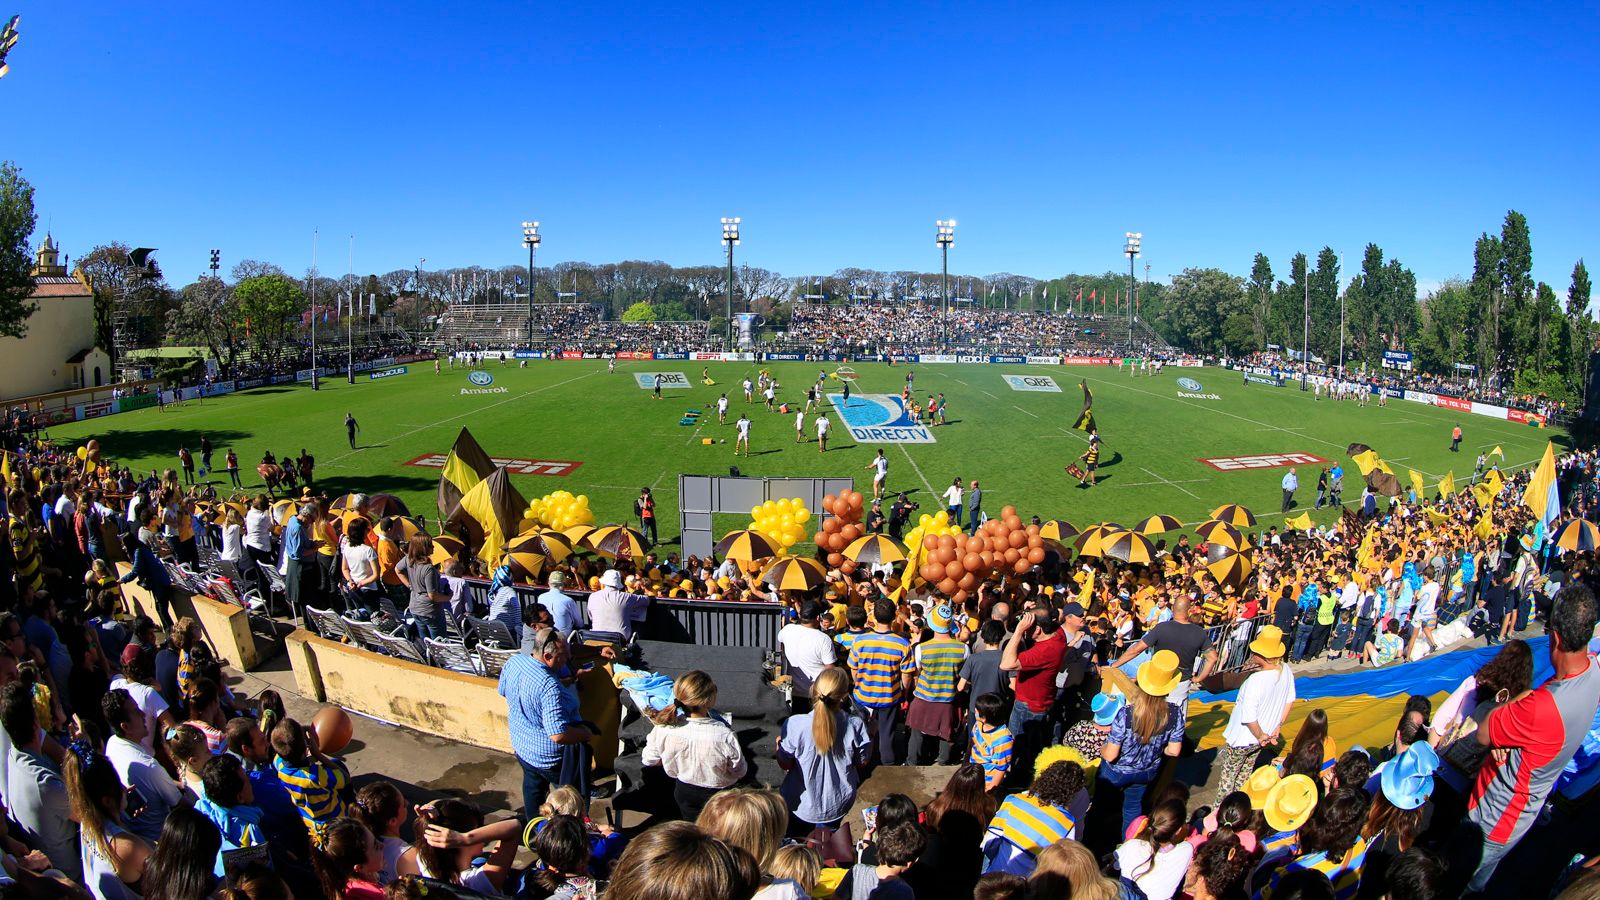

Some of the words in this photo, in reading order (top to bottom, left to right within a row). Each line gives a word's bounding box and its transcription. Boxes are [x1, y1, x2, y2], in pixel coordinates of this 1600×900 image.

[958, 355, 991, 363] MEDICUS
[371, 367, 405, 379] MEDICUS
[1023, 377, 1054, 387] QBE
[460, 387, 509, 395] Amarok
[1176, 391, 1222, 400] Amarok
[84, 402, 113, 417] ESPN
[1460, 402, 1472, 410] TCL
[851, 428, 929, 440] DIRECTV
[413, 454, 573, 475] EPN
[1206, 453, 1321, 470] ESPN
